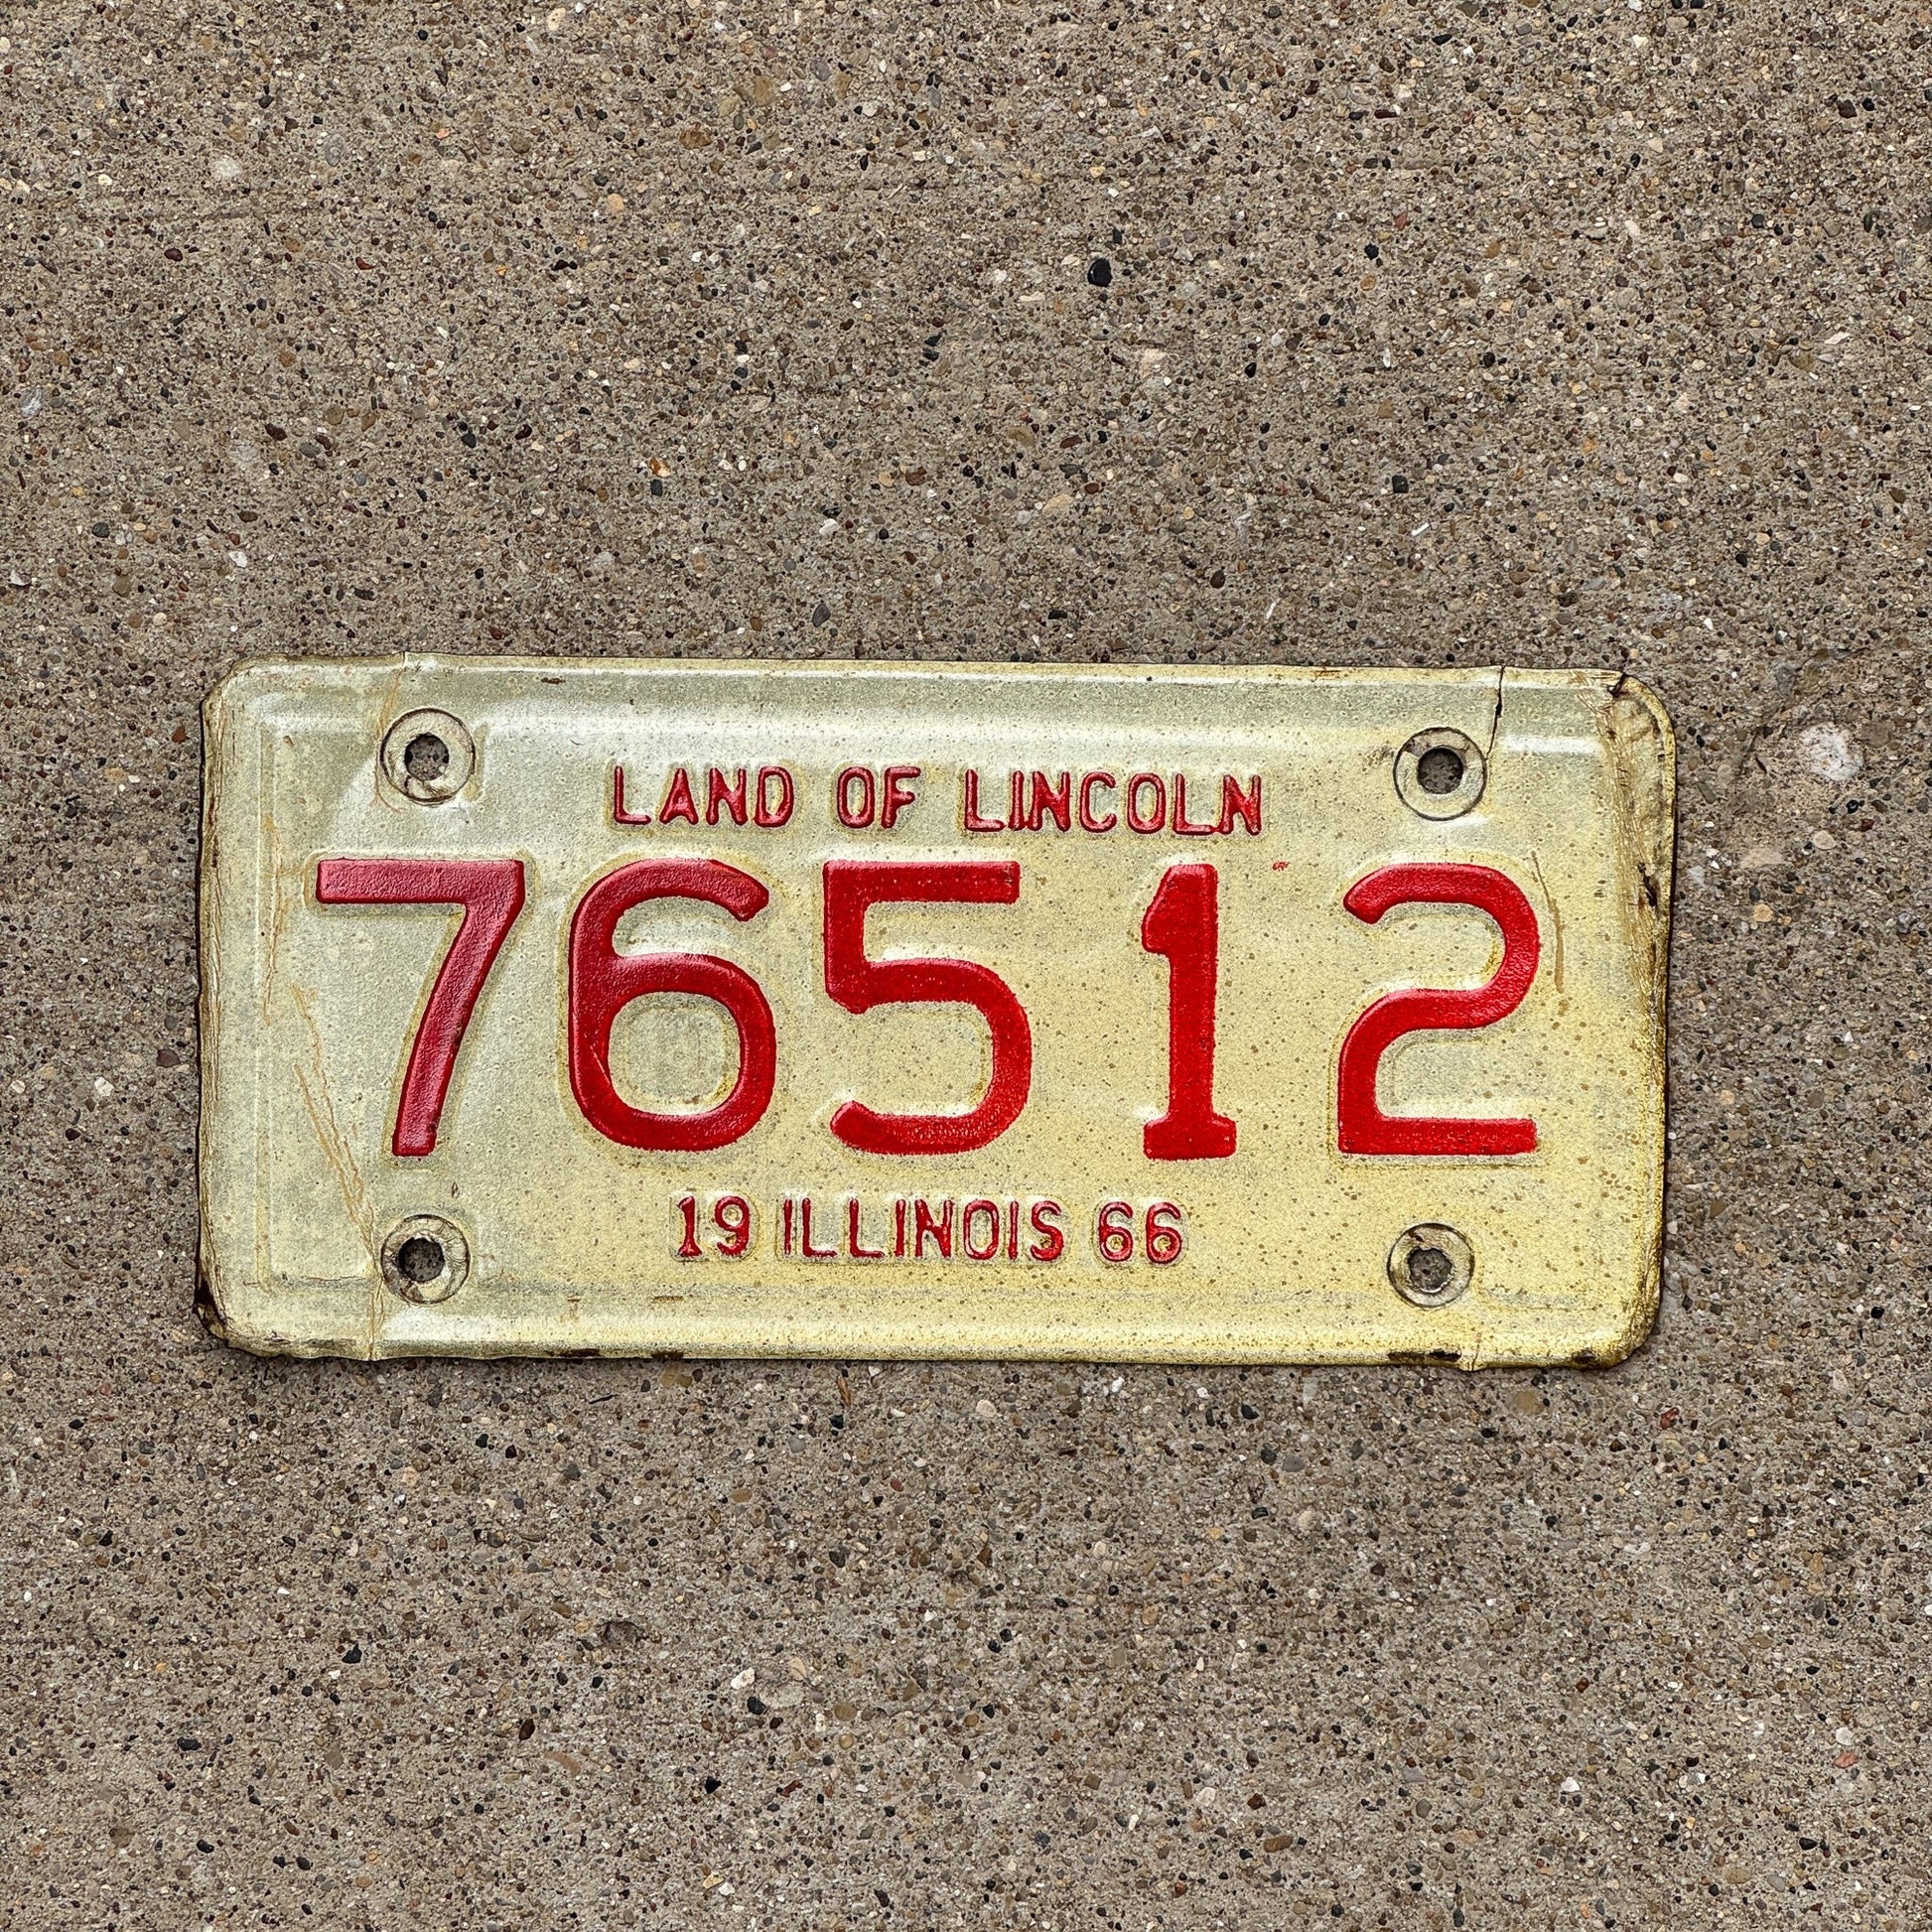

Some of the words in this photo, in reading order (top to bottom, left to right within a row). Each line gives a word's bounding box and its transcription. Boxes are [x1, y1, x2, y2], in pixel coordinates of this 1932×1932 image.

[612, 765, 796, 828] LAND
[835, 765, 922, 830] OF
[963, 767, 1264, 838] LINCOLN
[315, 857, 1543, 1162] 76512
[676, 1194, 752, 1260] 19
[781, 1196, 1066, 1264] ILLINOIS
[1097, 1200, 1184, 1265] 66
